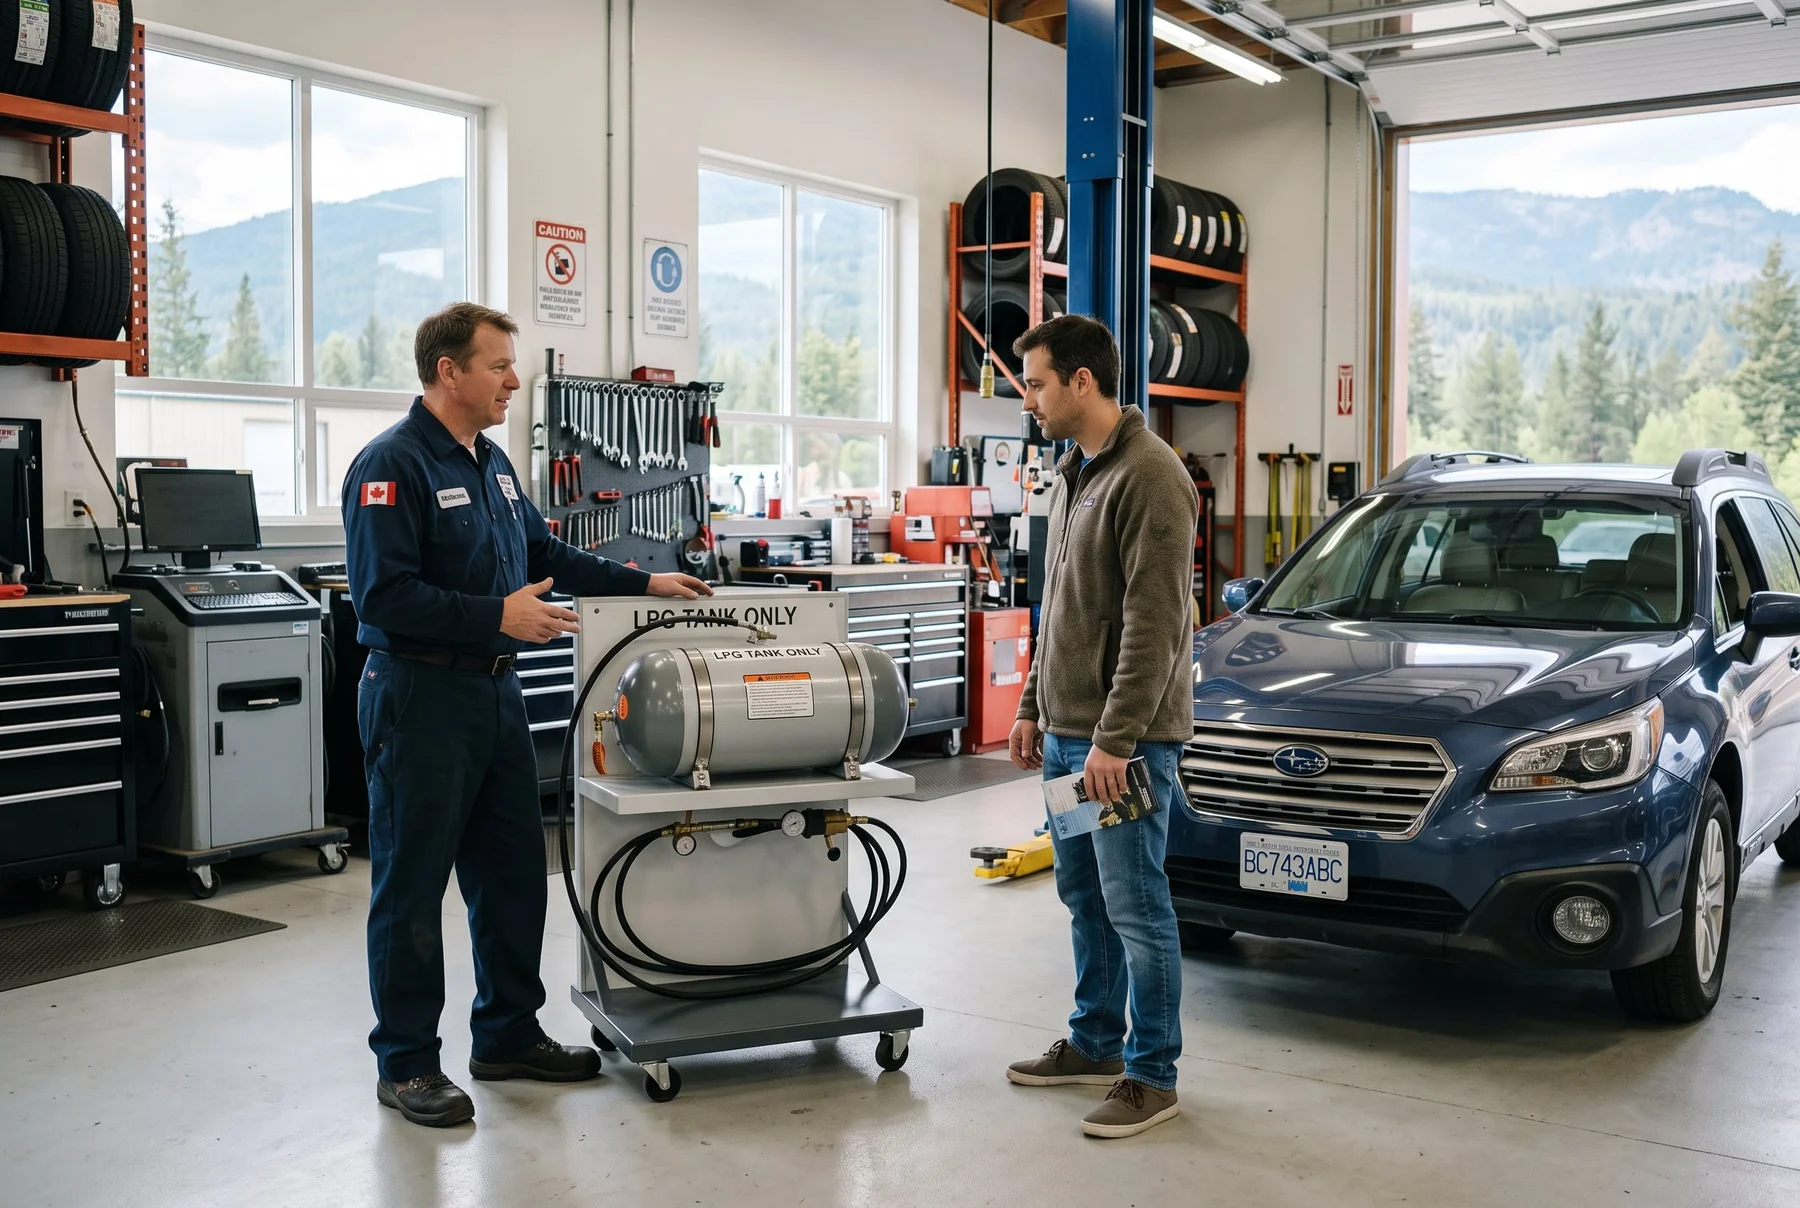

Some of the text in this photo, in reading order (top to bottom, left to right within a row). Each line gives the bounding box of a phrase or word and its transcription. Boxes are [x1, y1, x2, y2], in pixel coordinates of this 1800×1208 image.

[538, 224, 583, 241] CAUTION
[682, 608, 737, 628] TANK
[744, 606, 797, 625] ONLY
[714, 648, 820, 659] LPG TANK ONLY
[1244, 849, 1342, 883] BC743ABC
